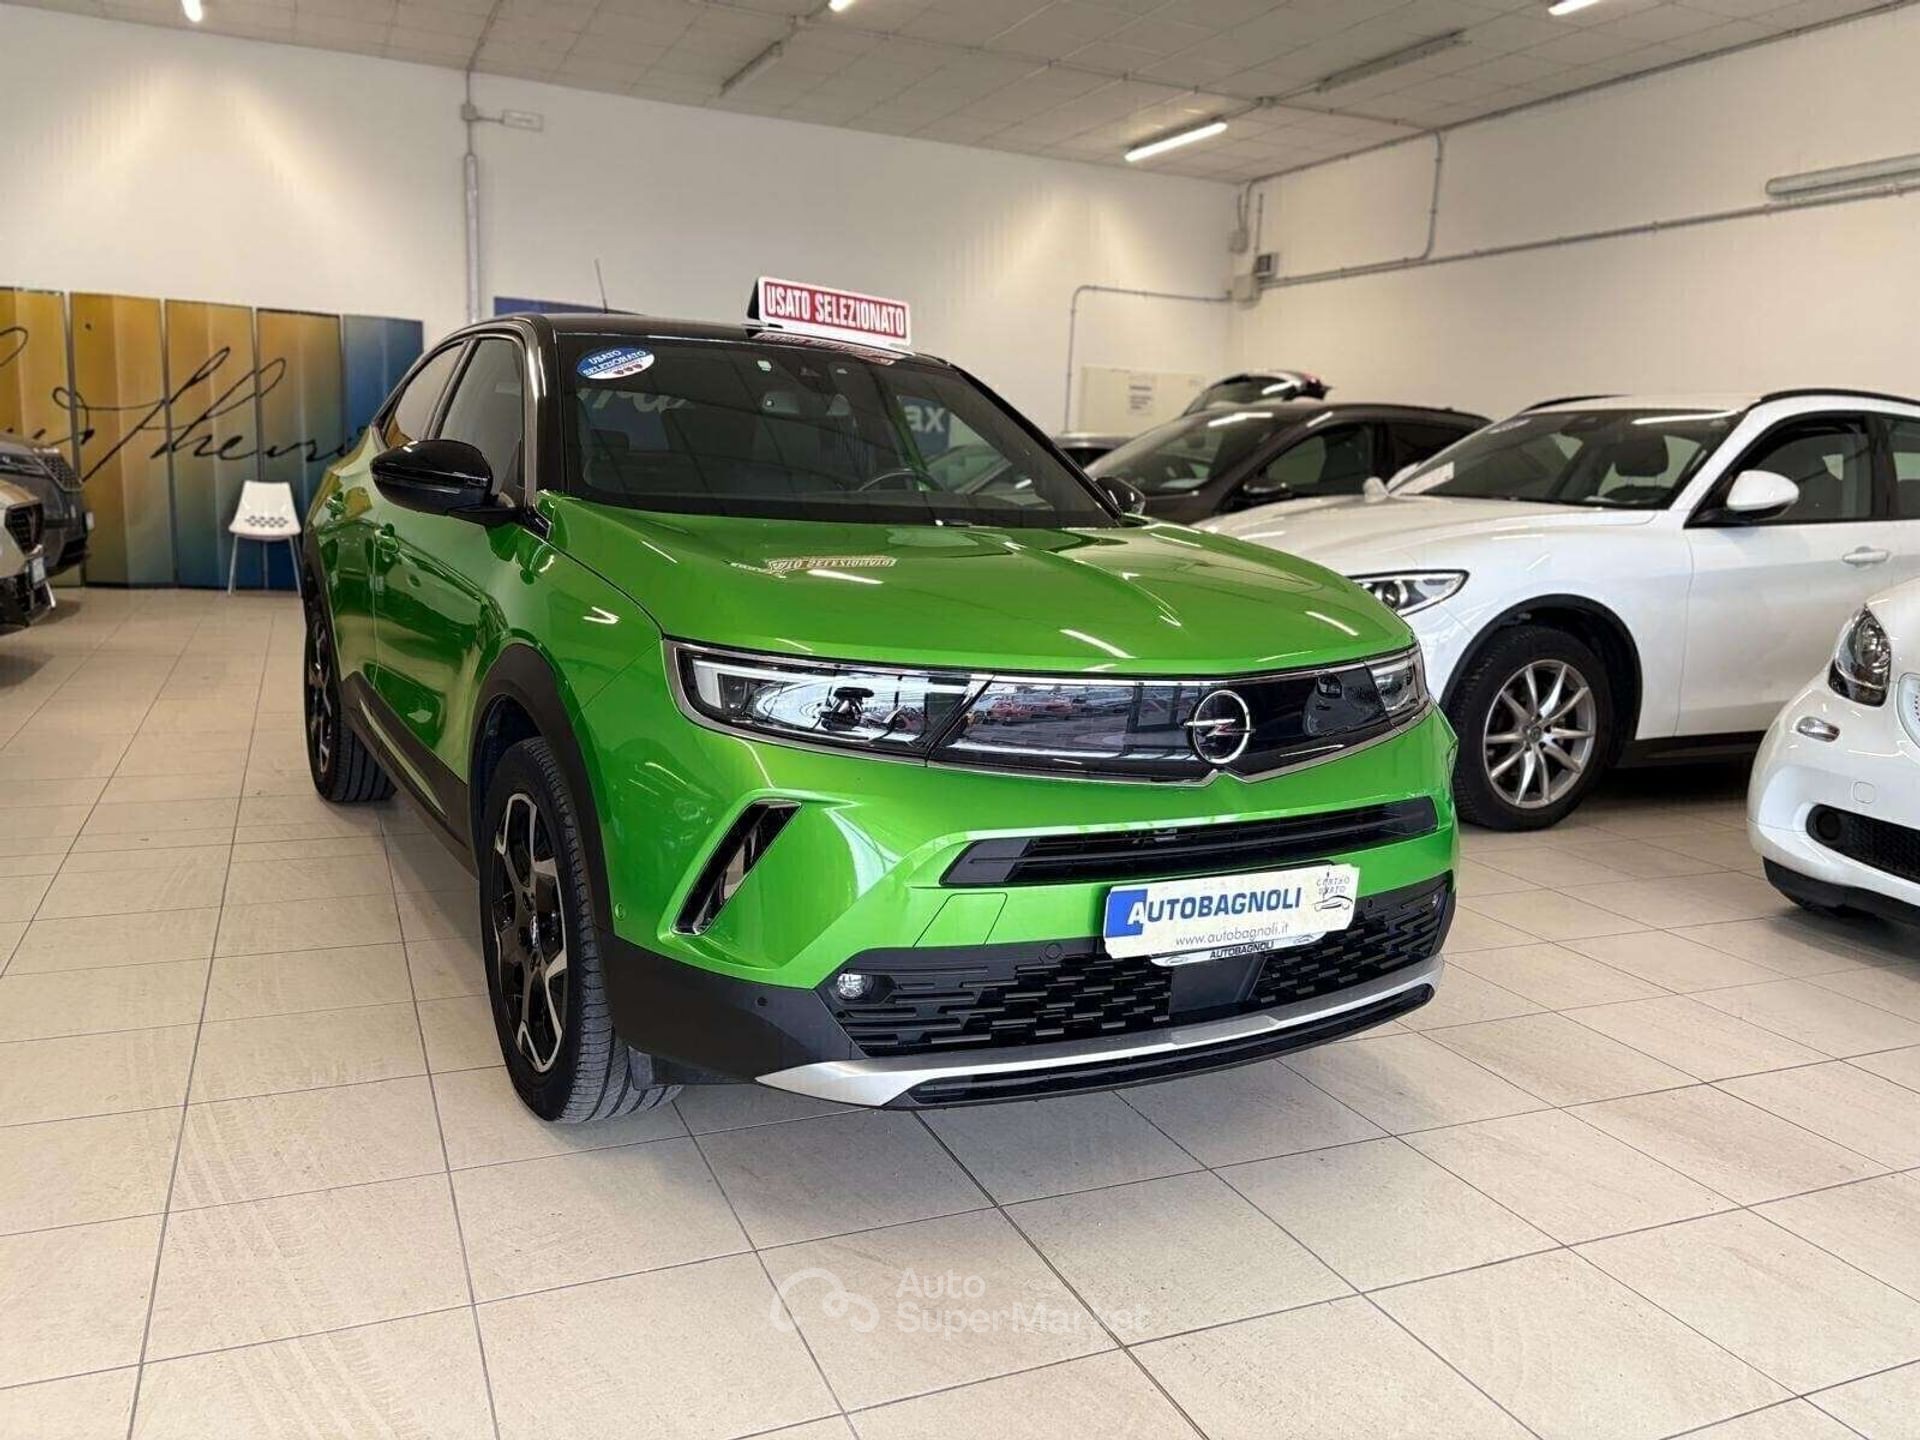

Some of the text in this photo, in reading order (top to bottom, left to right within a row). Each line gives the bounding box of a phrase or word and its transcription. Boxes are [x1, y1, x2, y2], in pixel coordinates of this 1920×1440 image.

[766, 285, 905, 337] USATO SELEZIONATO
[582, 350, 646, 375] SELEZIONATO
[589, 350, 622, 365] USATO
[1126, 887, 1303, 926] AUTOBAGNOLI
[1175, 922, 1289, 946] www.autobagnoli.it
[1209, 940, 1275, 959] AUTOBAGNOLI
